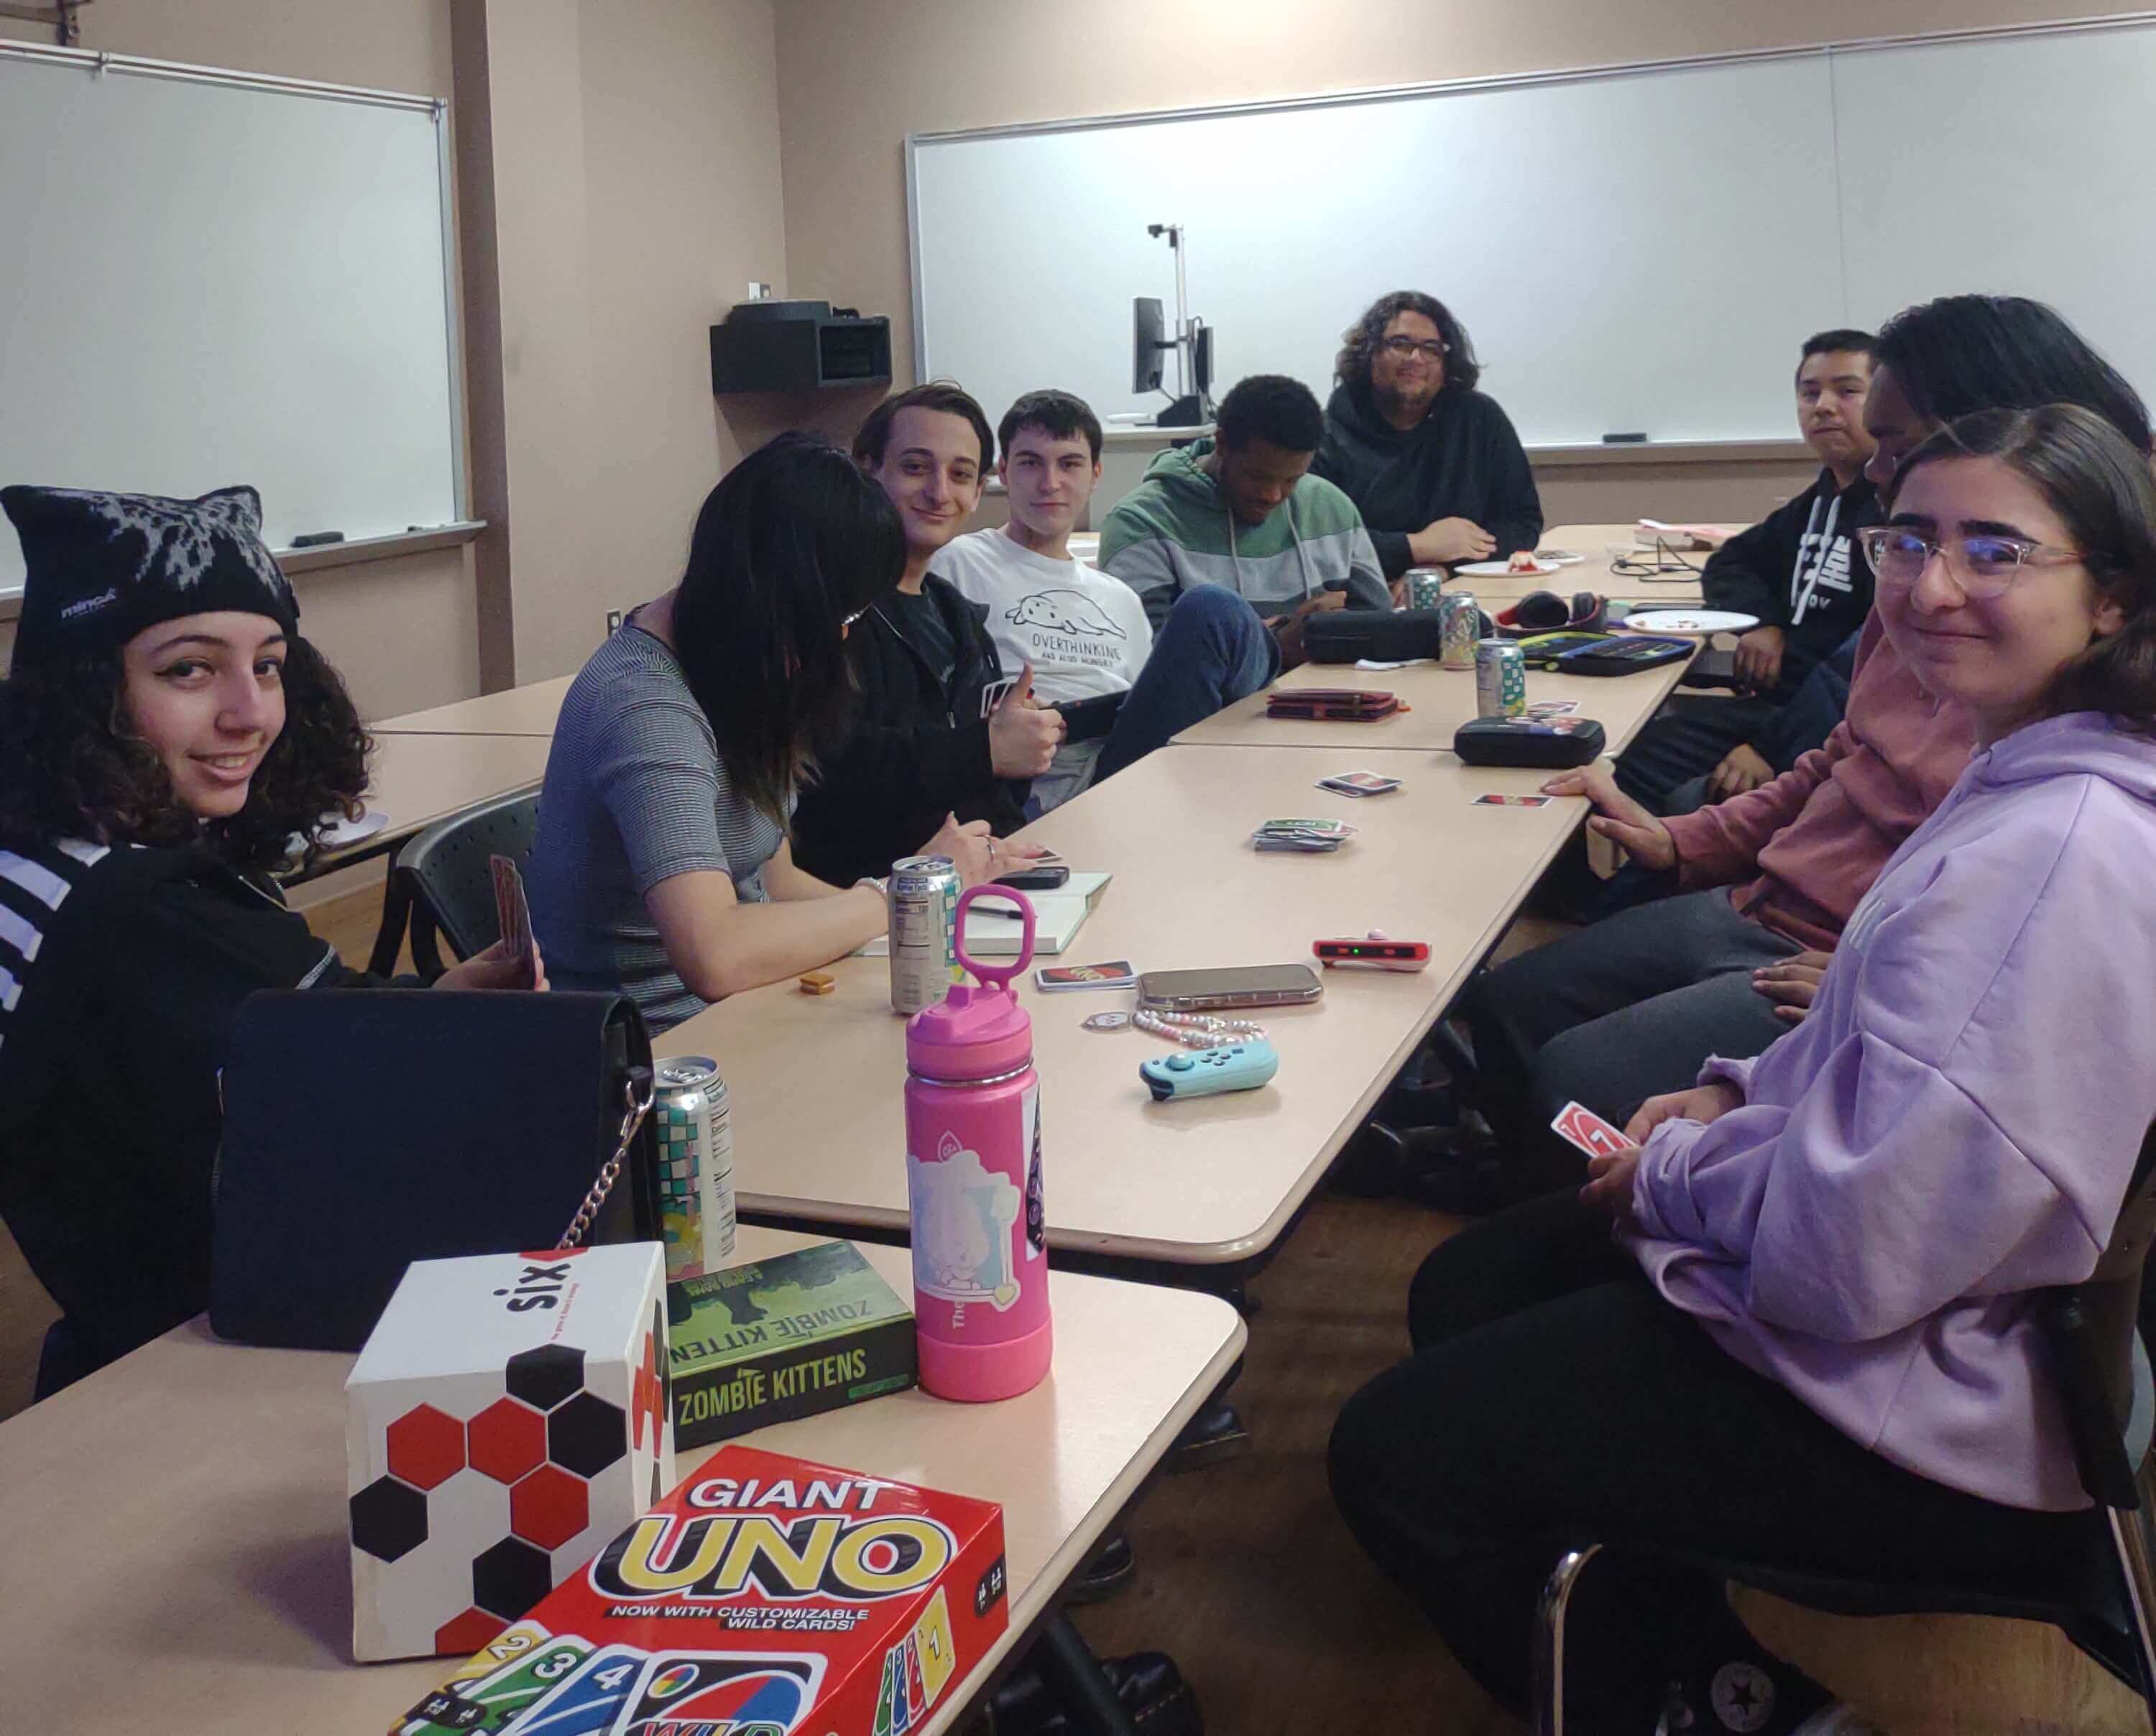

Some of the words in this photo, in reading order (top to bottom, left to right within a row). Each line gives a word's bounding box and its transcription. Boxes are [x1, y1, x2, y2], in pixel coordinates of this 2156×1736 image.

[493, 1263, 571, 1312] six
[770, 1300, 875, 1336] ZOMBIE
[671, 1326, 767, 1364] KITTEN
[678, 1369, 768, 1426] ZOMBIE
[773, 1349, 867, 1401] KITTENS
[688, 1478, 891, 1510] GIANT
[604, 1514, 956, 1599] UNO
[612, 1606, 661, 1617] NOW
[664, 1606, 713, 1618] WITH
[717, 1607, 870, 1620] CUSTOMIZABLE
[727, 1617, 779, 1630] WILD
[781, 1618, 855, 1630] CARDS!
[490, 1635, 532, 1661] 2
[534, 1653, 577, 1679] 3
[593, 1663, 635, 1691] 4
